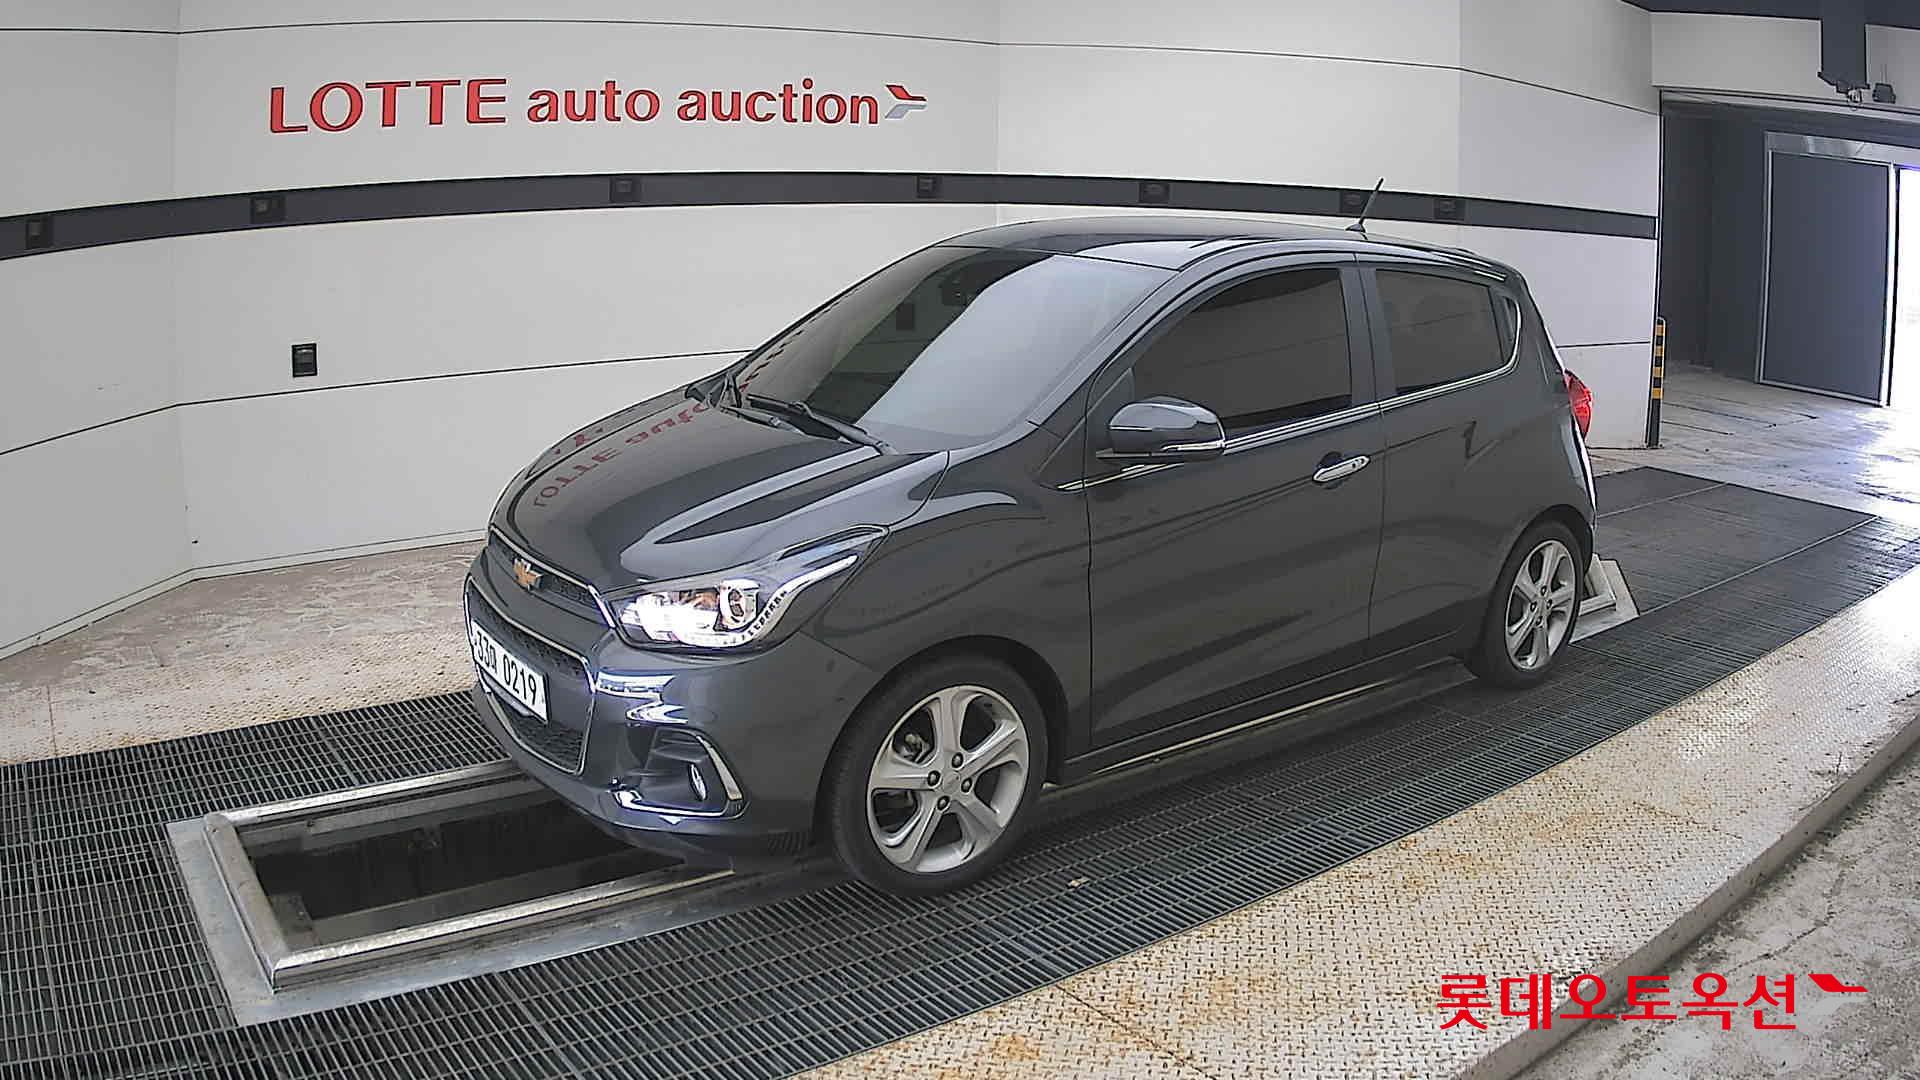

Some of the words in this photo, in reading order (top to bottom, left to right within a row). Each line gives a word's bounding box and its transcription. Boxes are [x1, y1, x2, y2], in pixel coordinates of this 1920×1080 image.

[270, 79, 507, 133] LOTTE
[527, 80, 661, 123] auto
[677, 78, 879, 125] auction
[503, 653, 537, 706] 0219
